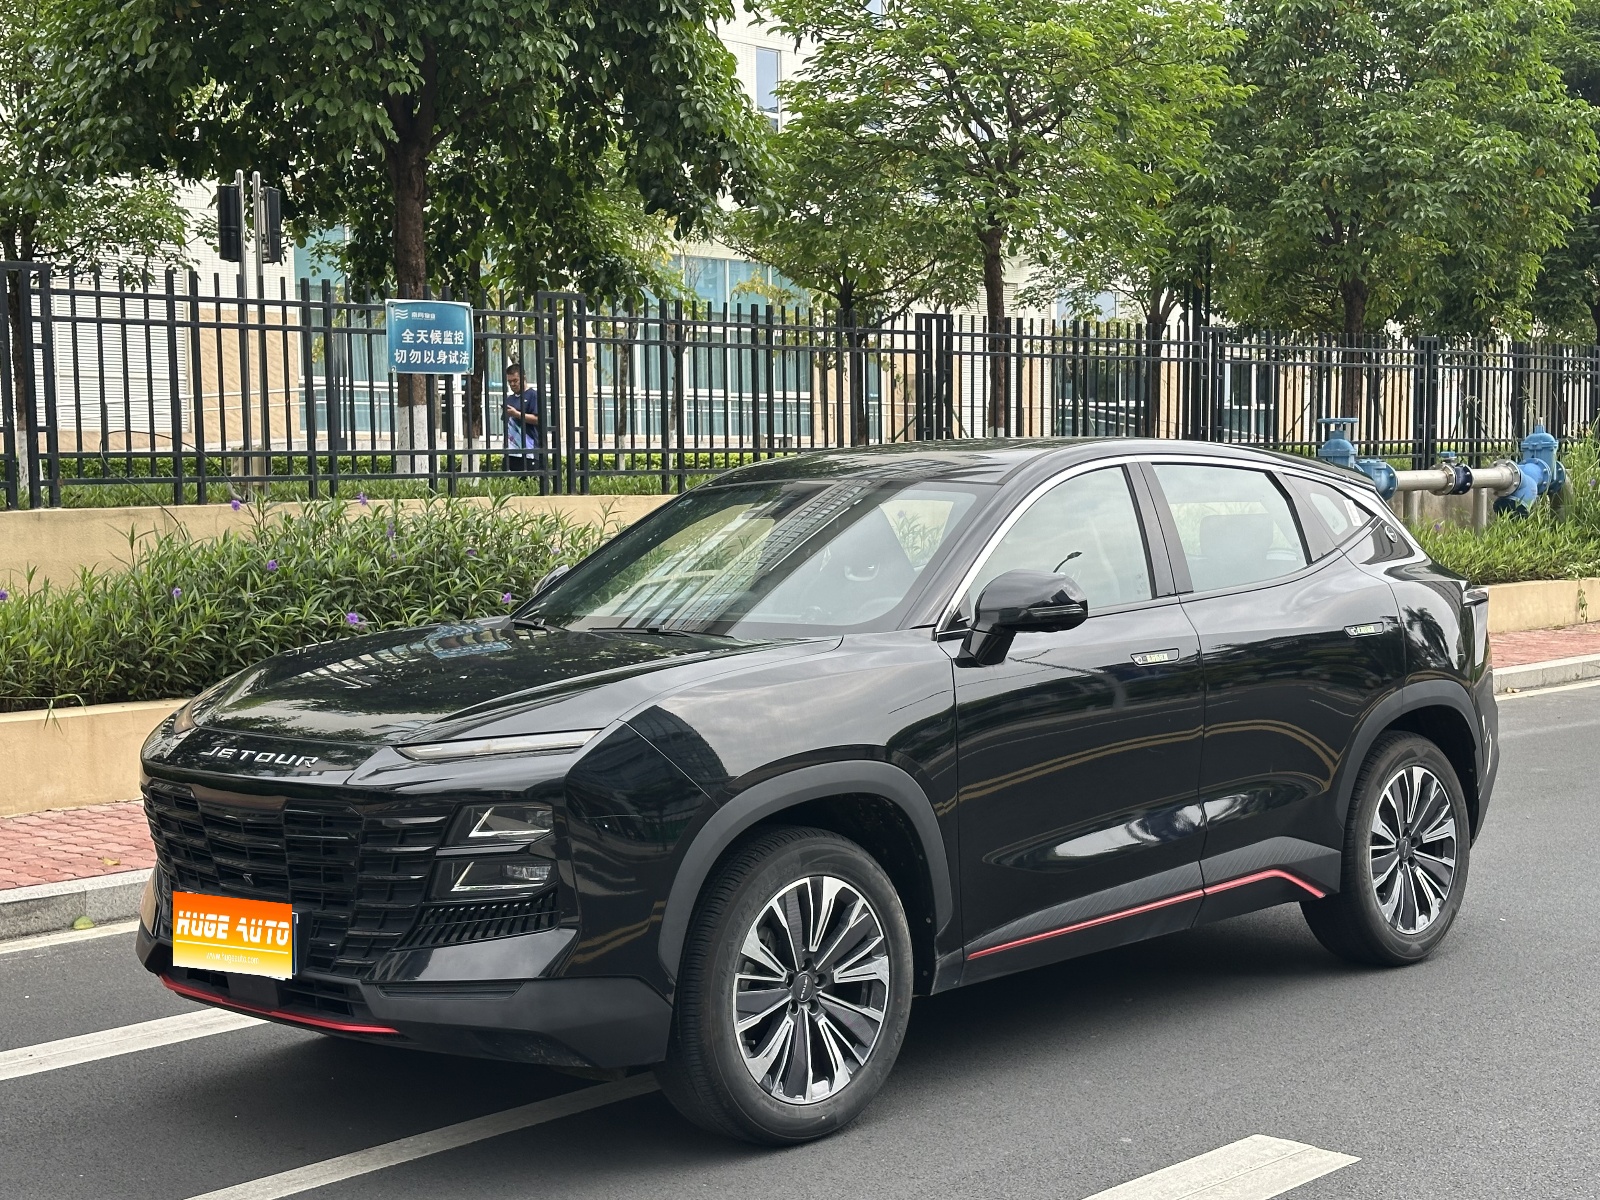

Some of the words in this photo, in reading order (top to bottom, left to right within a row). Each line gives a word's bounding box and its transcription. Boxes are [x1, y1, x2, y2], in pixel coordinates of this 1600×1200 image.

[401, 328, 465, 345] 全天候监控
[394, 348, 470, 365] 切勿以身试法
[198, 746, 319, 768] JETOUR
